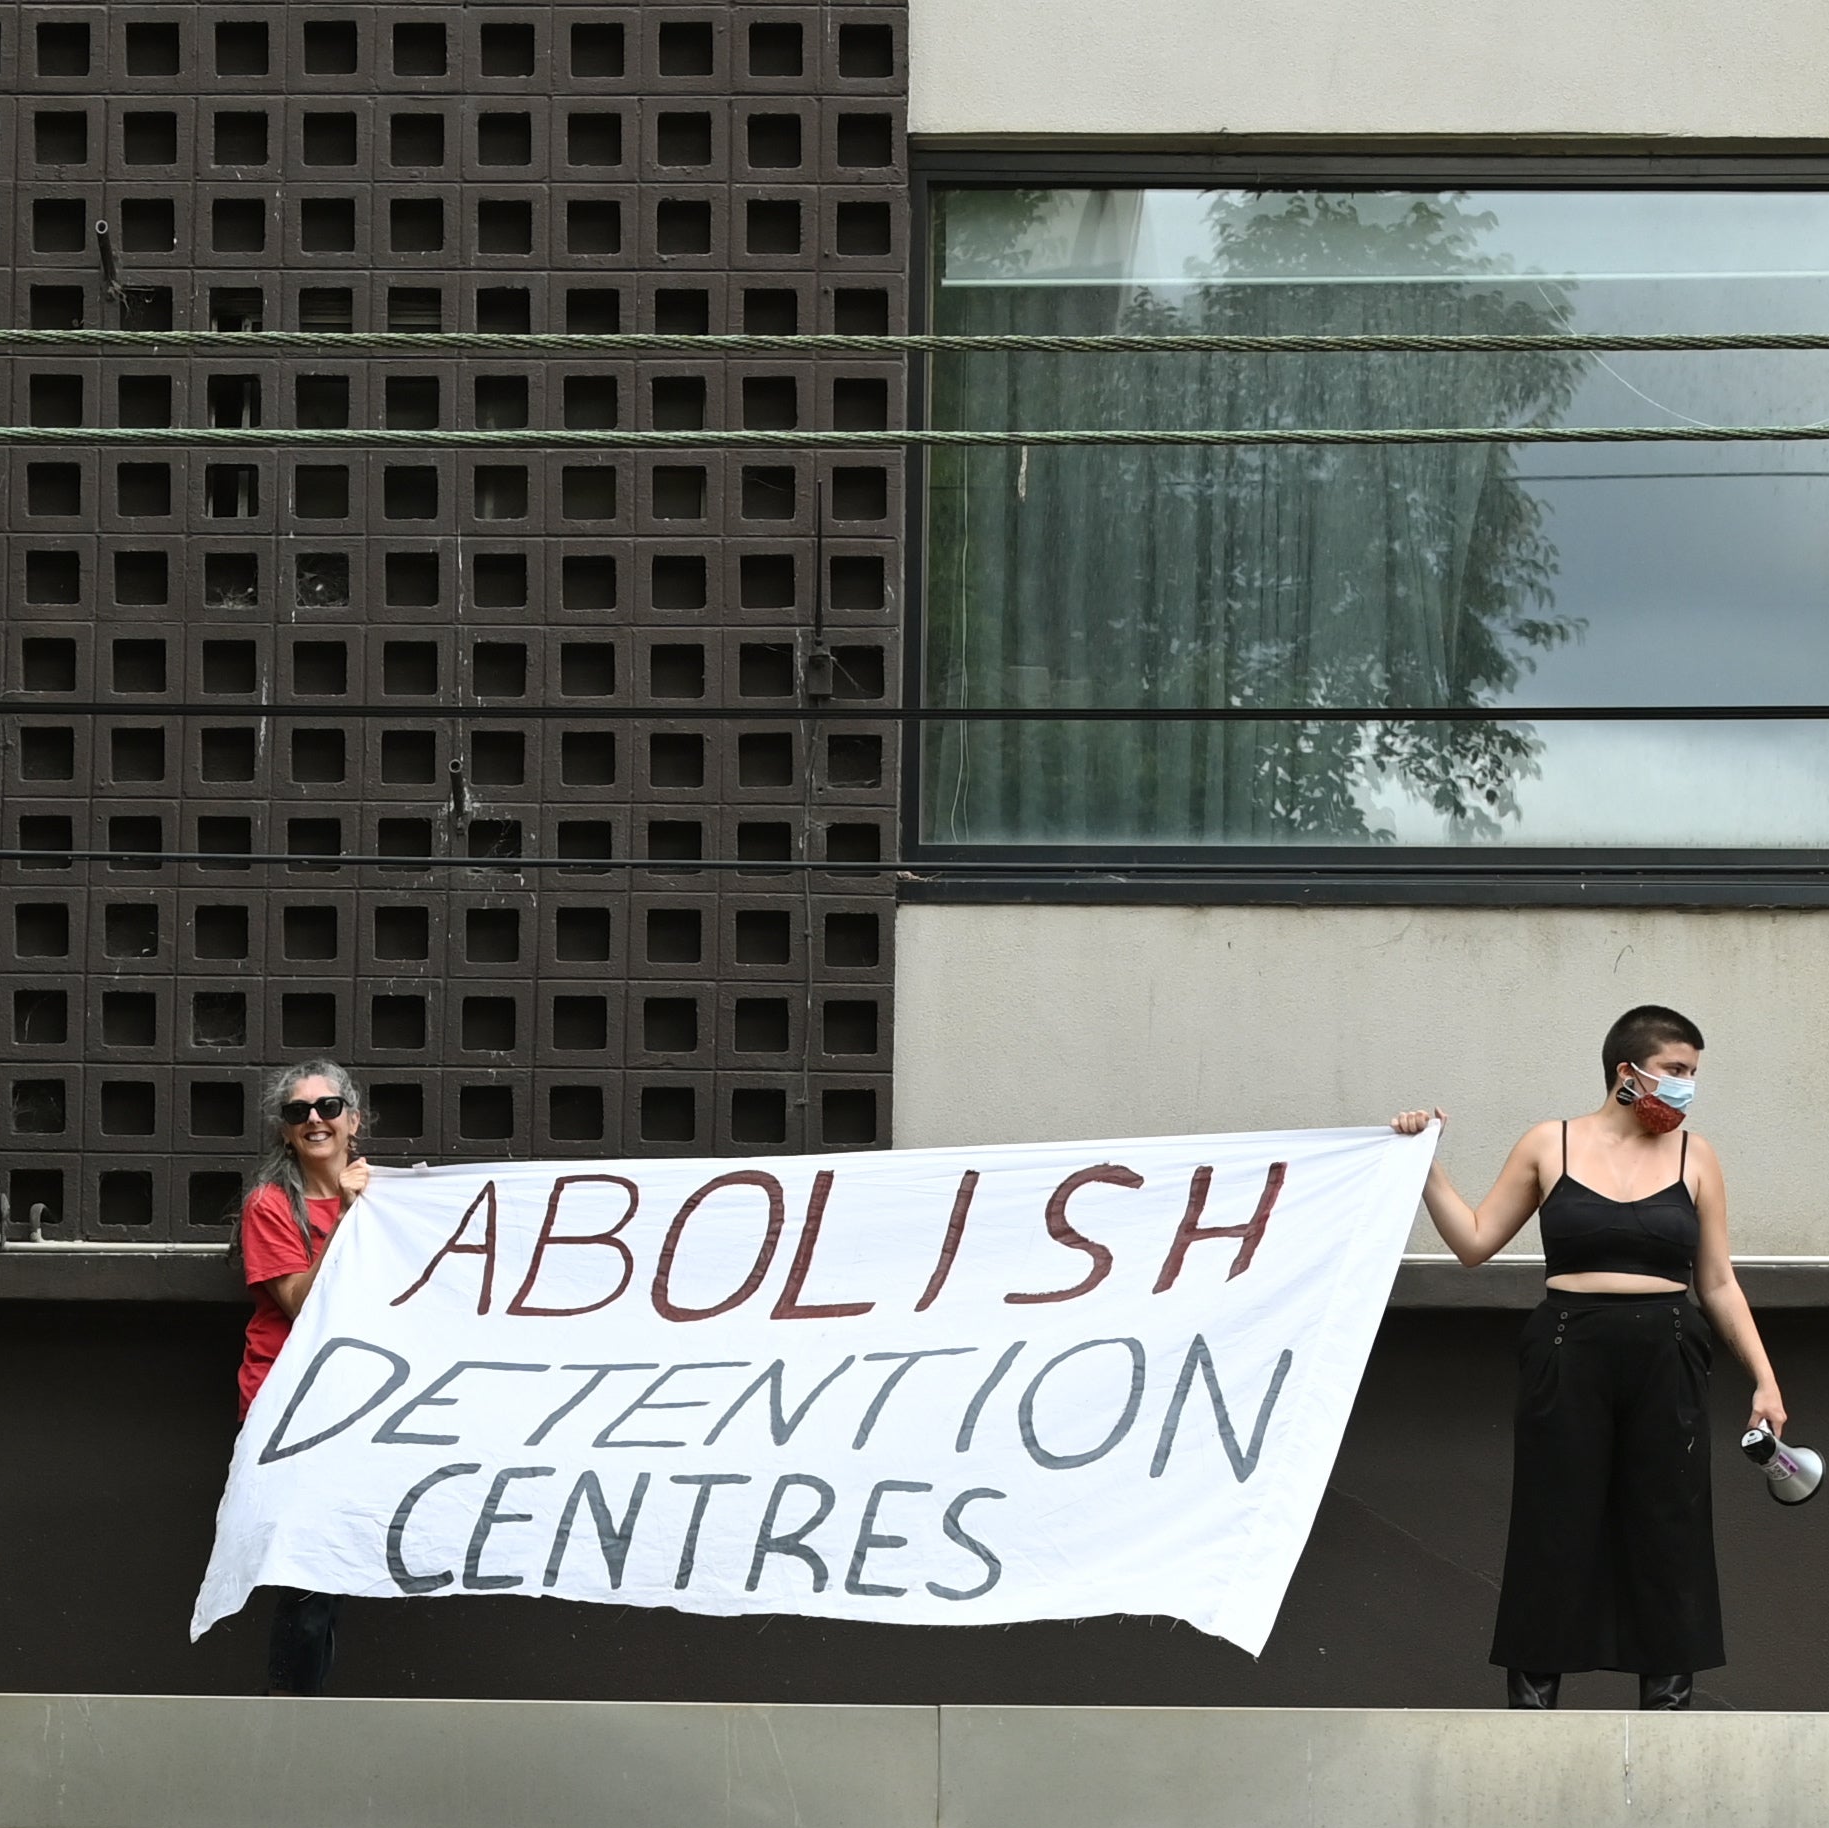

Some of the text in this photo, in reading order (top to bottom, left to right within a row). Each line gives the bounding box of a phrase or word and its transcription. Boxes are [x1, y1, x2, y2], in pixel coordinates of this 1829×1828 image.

[389, 1161, 1286, 1321] ABOLISH
[259, 1334, 1292, 1482] DETENTION
[385, 1464, 1006, 1599] CENTRES
